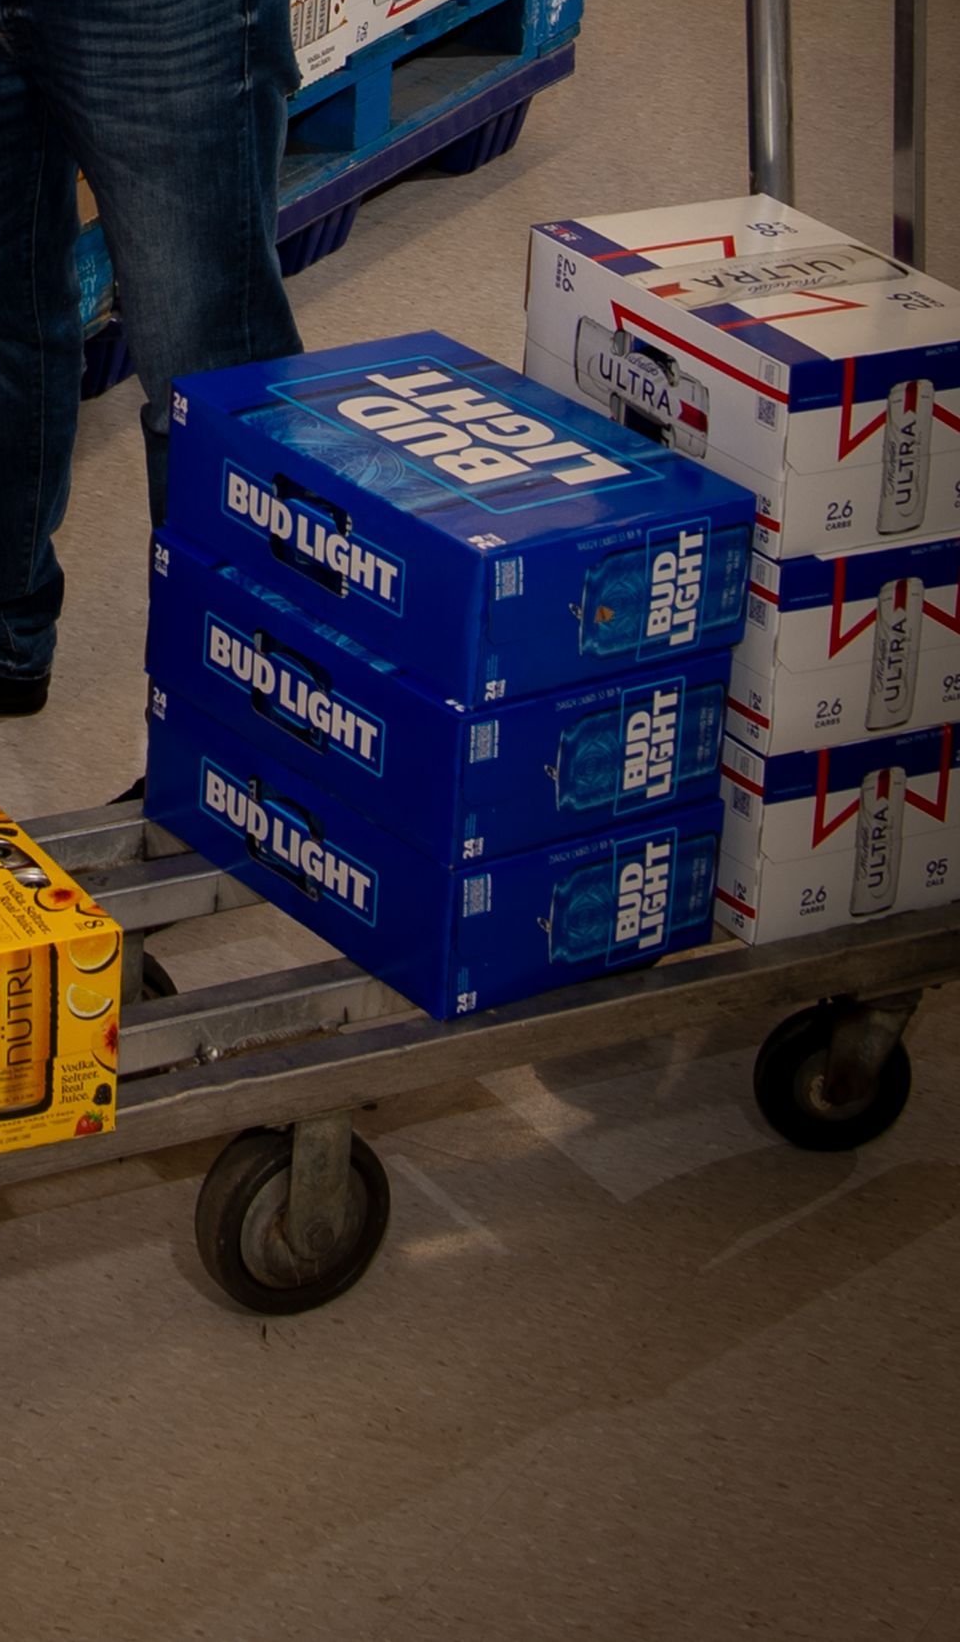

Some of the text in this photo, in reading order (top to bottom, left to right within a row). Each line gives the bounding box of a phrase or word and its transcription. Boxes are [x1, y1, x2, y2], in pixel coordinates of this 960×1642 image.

[366, 367, 634, 487] LIGHT
[600, 352, 673, 420] ULTRA
[337, 392, 534, 485] BUD
[894, 418, 917, 507] ULTRA
[227, 473, 399, 603] BUD LIGHT
[825, 519, 852, 532] CARBS
[826, 499, 853, 520] 2.6
[646, 551, 676, 639] BUD
[668, 528, 706, 648] LIGHT
[210, 623, 380, 763] BUD LIGHT
